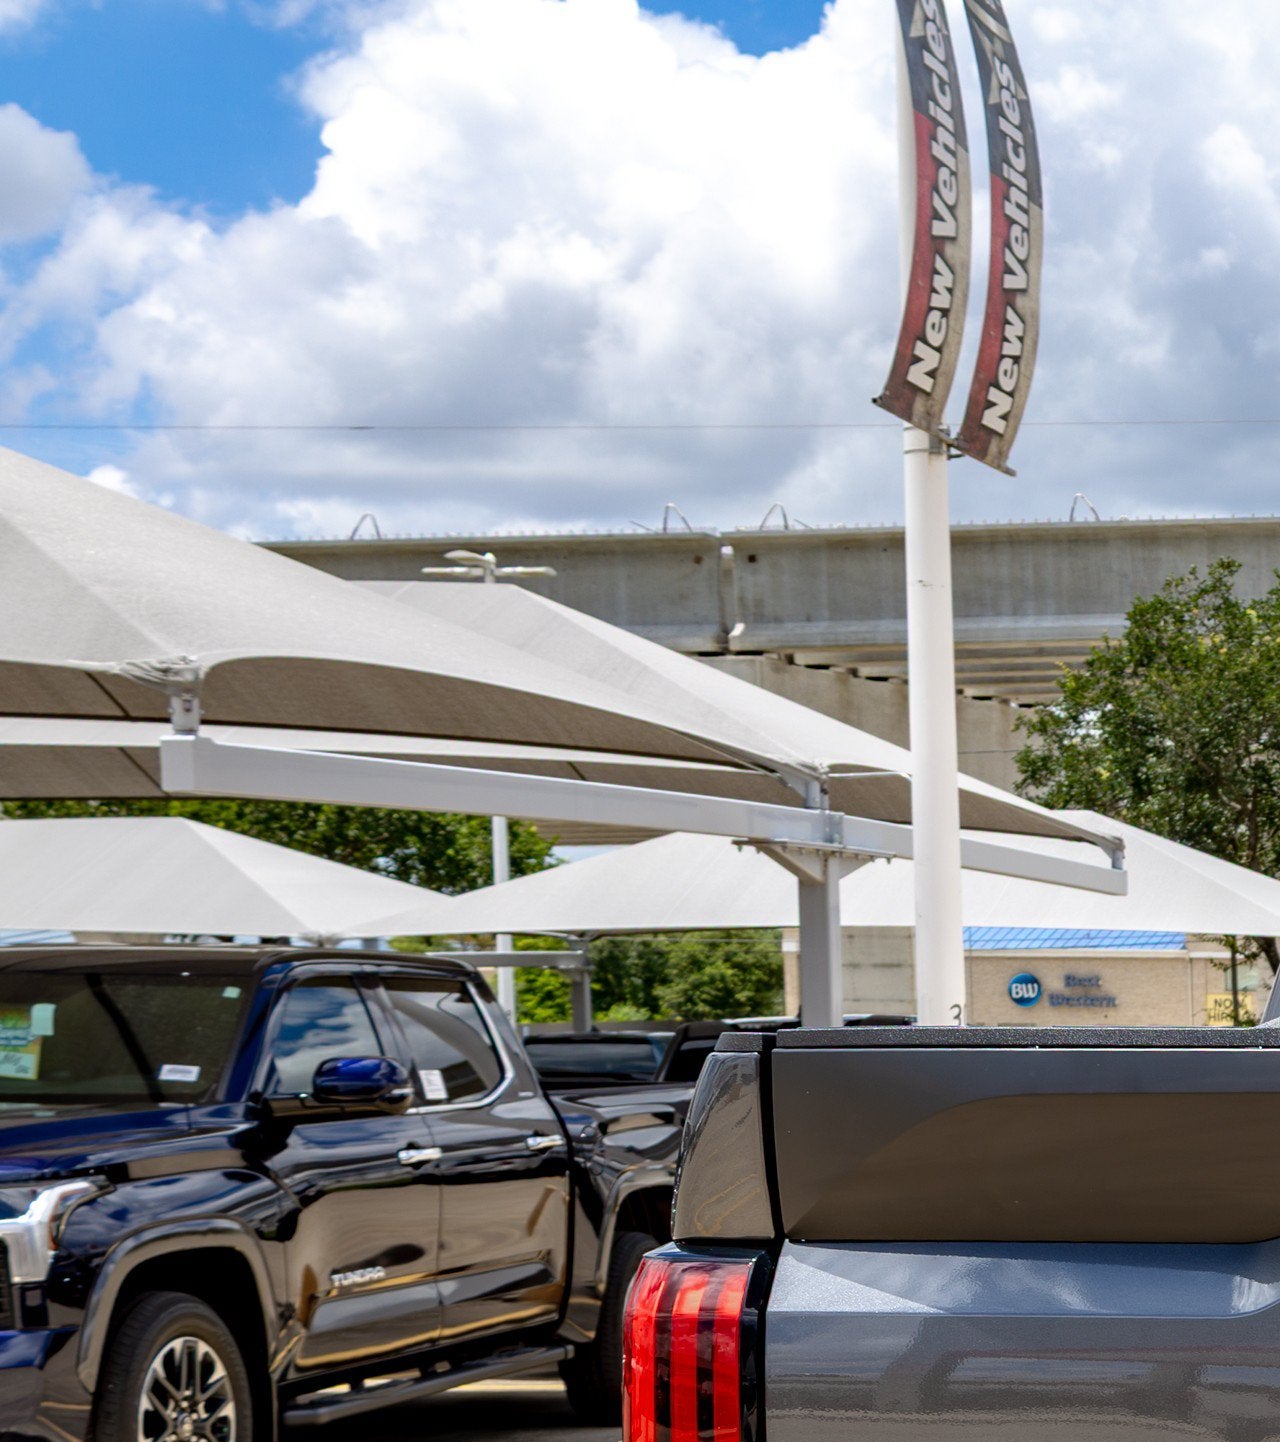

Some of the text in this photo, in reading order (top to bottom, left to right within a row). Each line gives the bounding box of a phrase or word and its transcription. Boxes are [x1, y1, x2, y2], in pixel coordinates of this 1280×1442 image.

[906, 0, 958, 393] New Vehicles
[981, 55, 1030, 435] New Vehicles
[1011, 983, 1039, 999] BW
